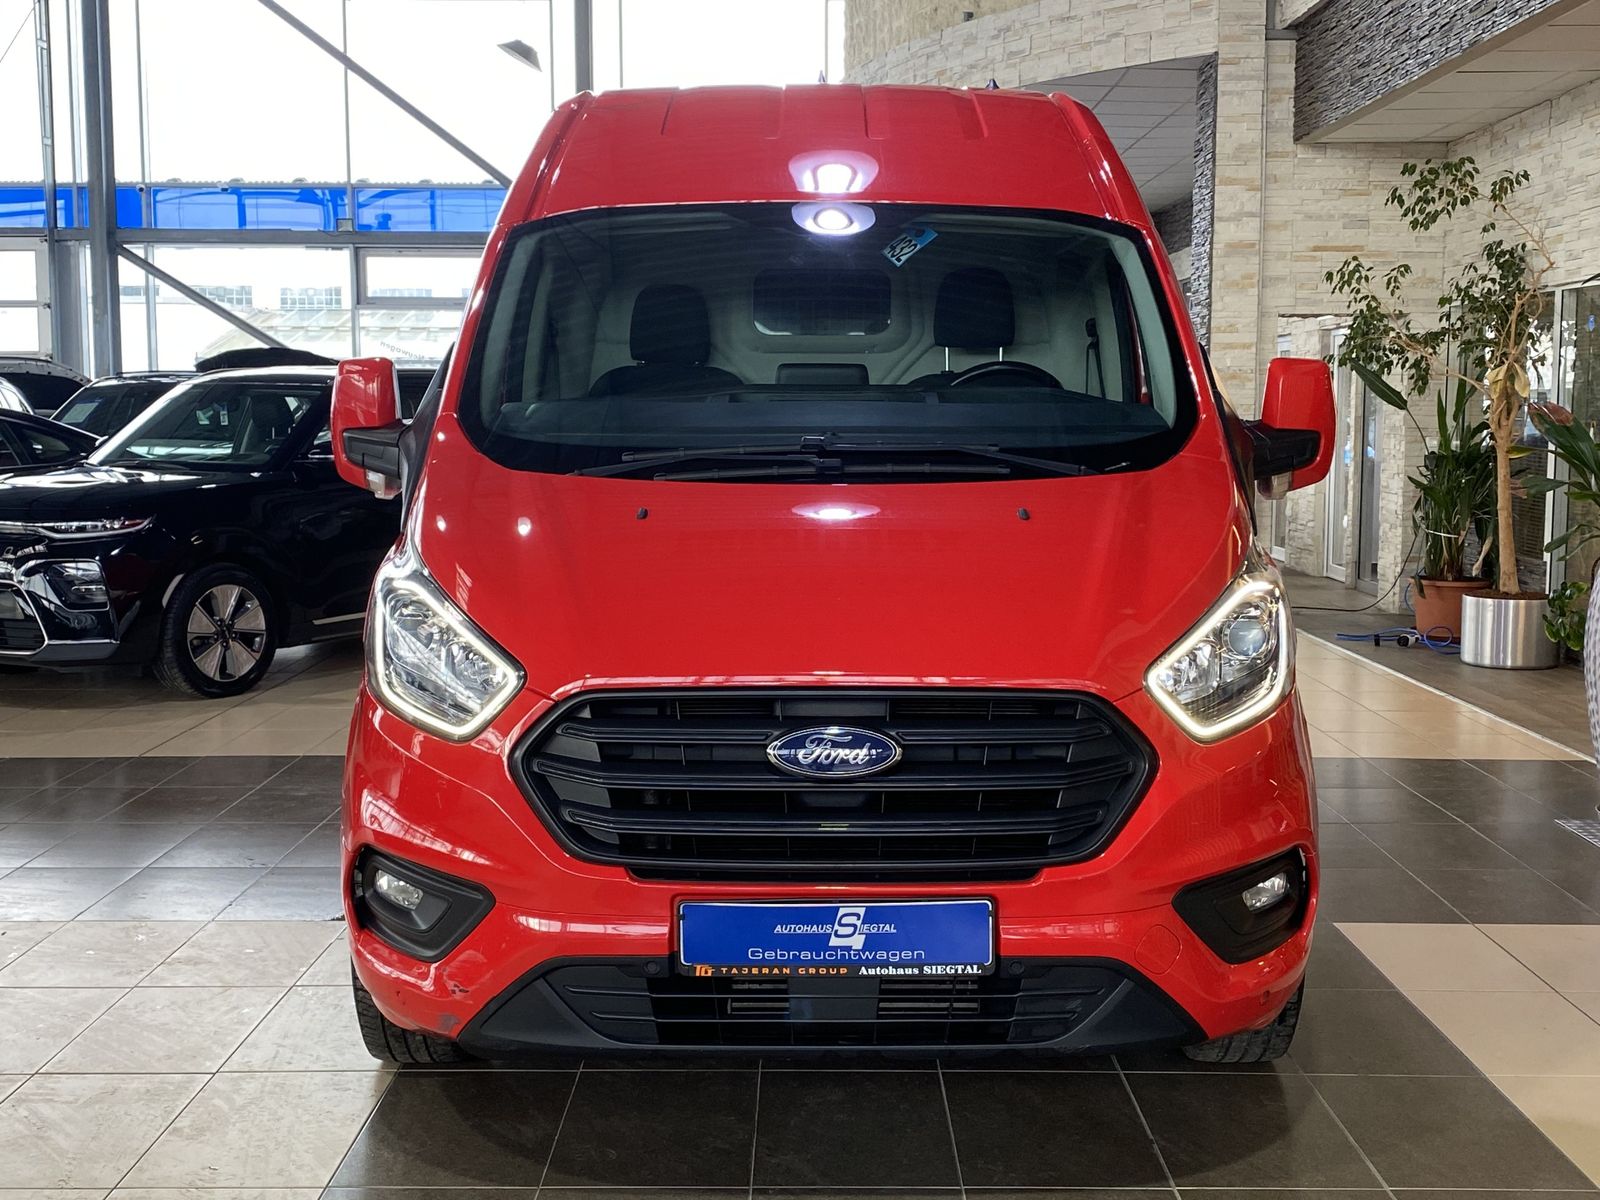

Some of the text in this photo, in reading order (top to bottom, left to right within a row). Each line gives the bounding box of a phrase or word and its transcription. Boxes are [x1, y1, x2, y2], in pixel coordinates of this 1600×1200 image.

[887, 235, 918, 263] 432
[798, 734, 871, 765] Ford
[773, 924, 833, 934] AUTOHAUS
[747, 948, 925, 962] Gebrauchtwagen
[858, 964, 982, 975] Autohaus SIEGTAL
